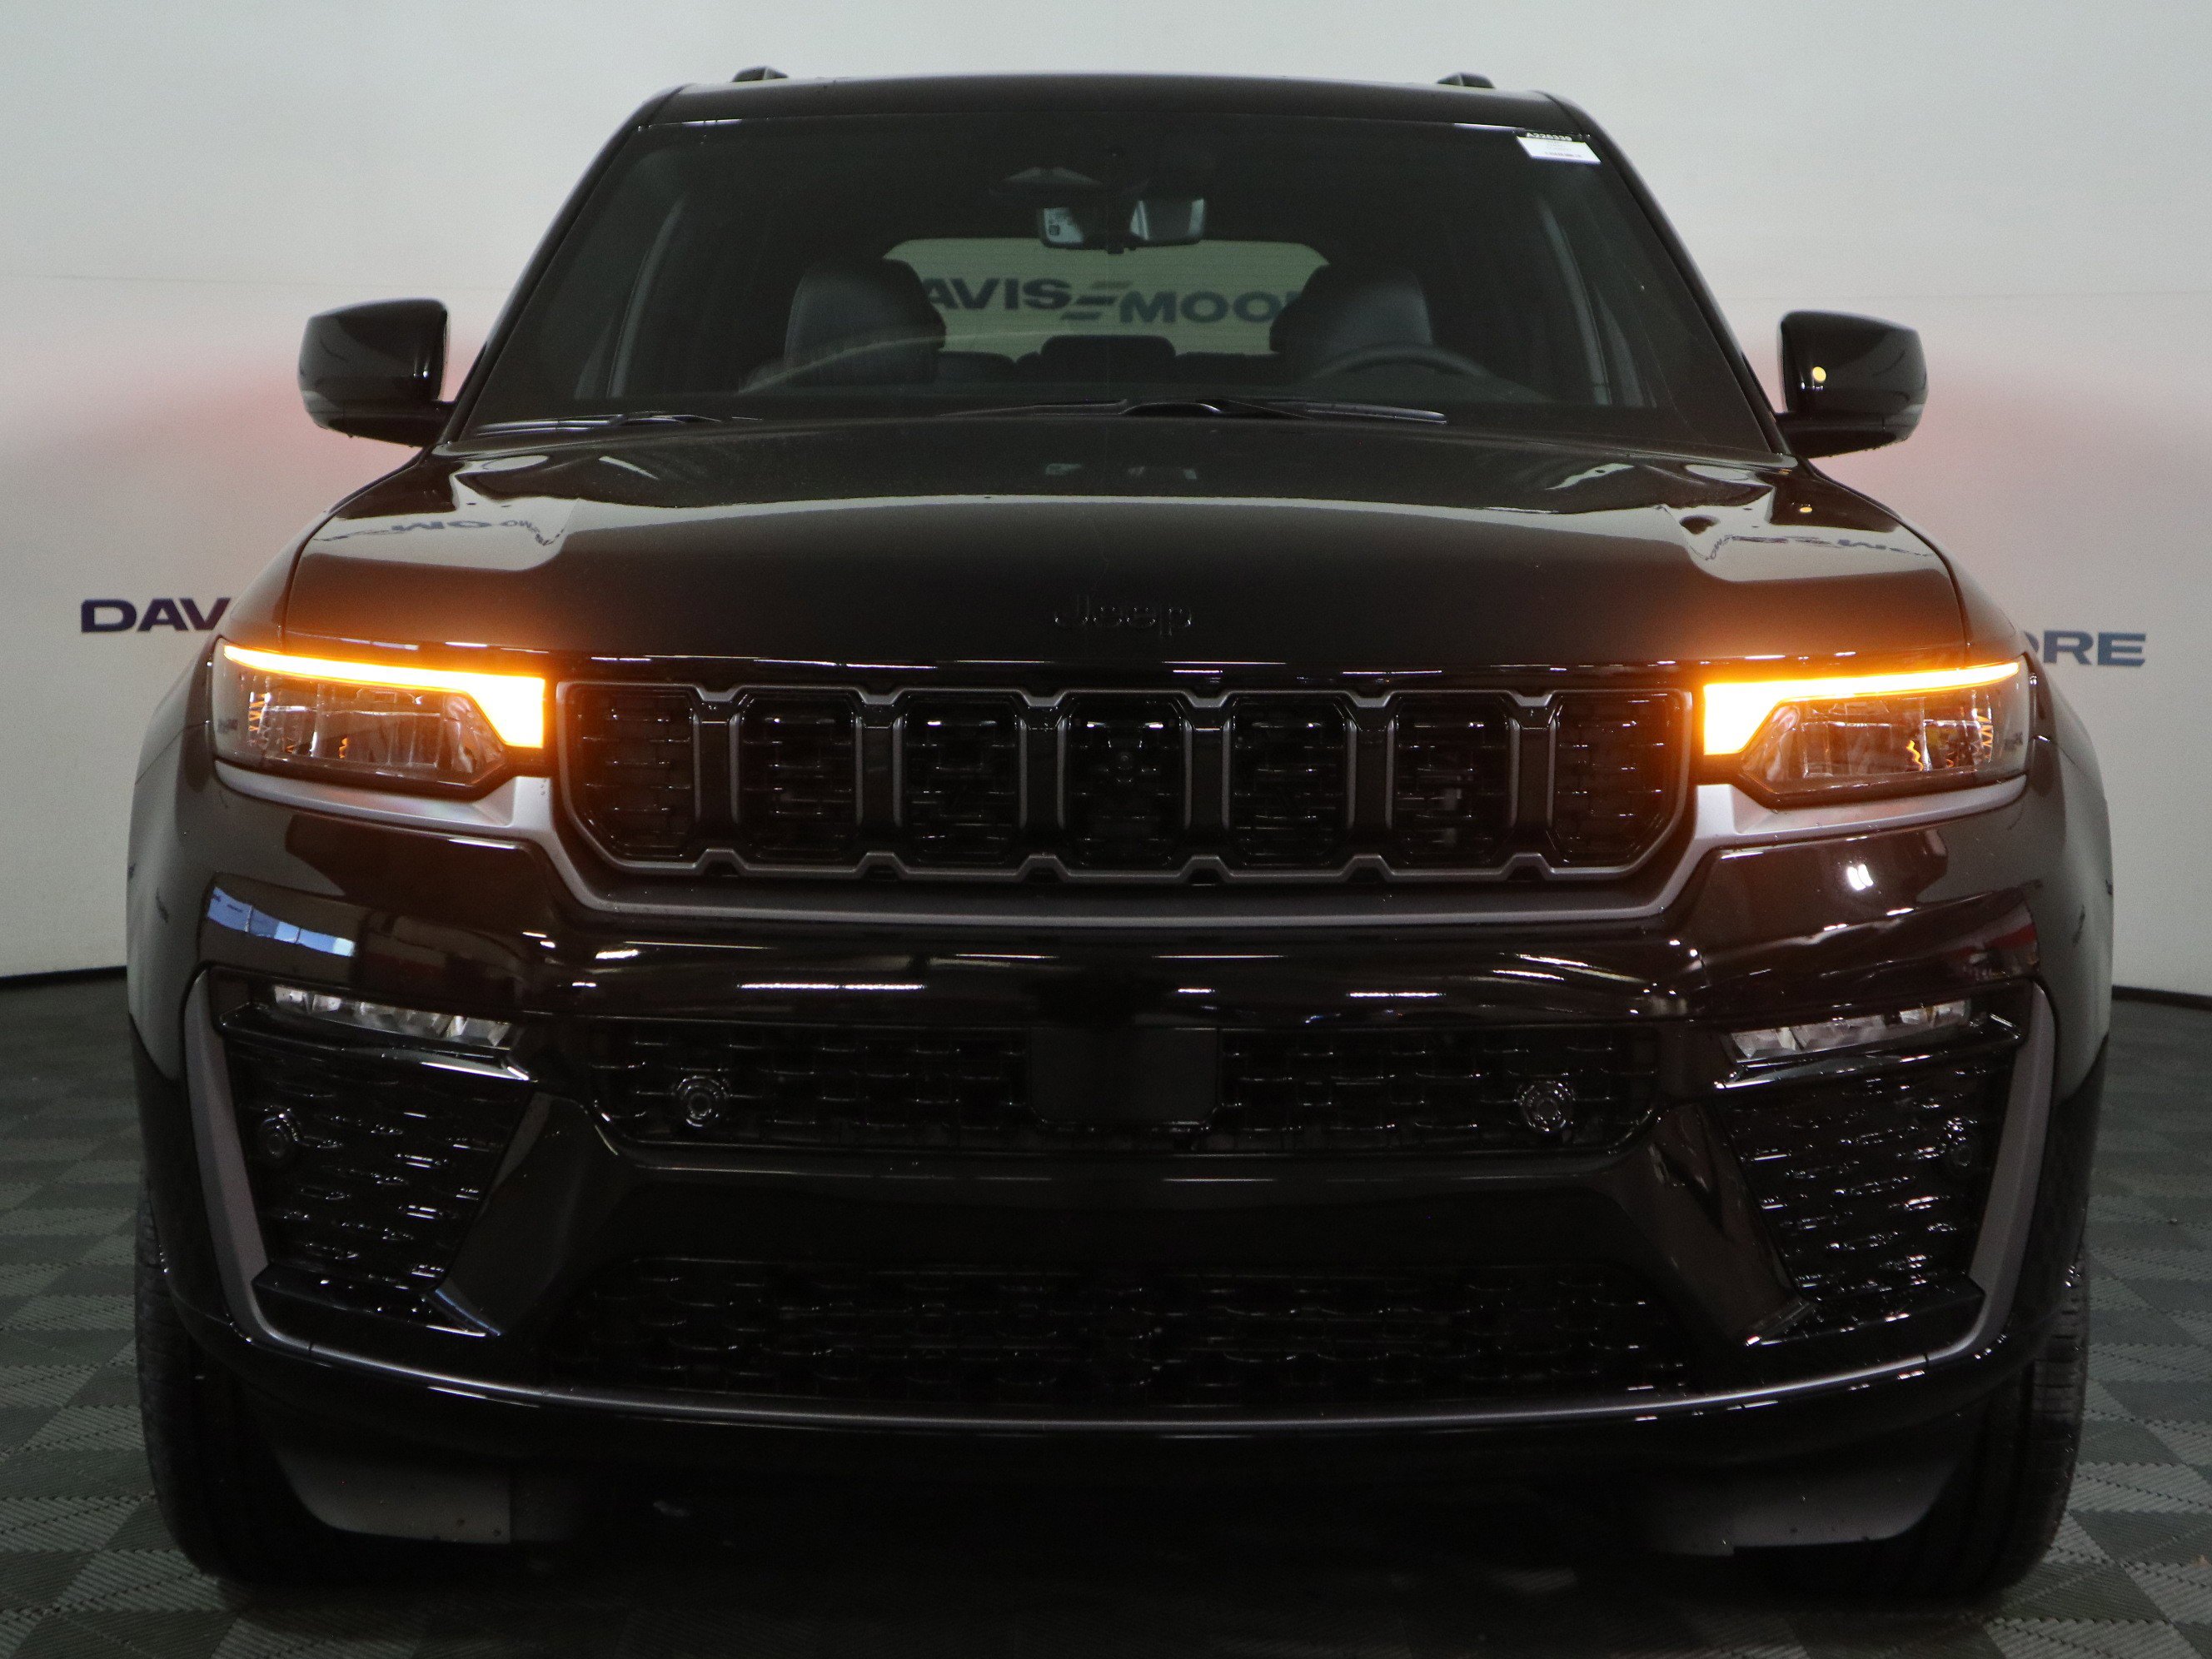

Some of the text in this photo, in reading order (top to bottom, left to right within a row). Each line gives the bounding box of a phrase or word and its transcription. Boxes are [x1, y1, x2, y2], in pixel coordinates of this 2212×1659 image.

[921, 277, 1301, 324] AVIS MOO
[81, 597, 232, 633] DAV
[1054, 594, 1192, 637] Jeep
[2024, 630, 2146, 666] RE
